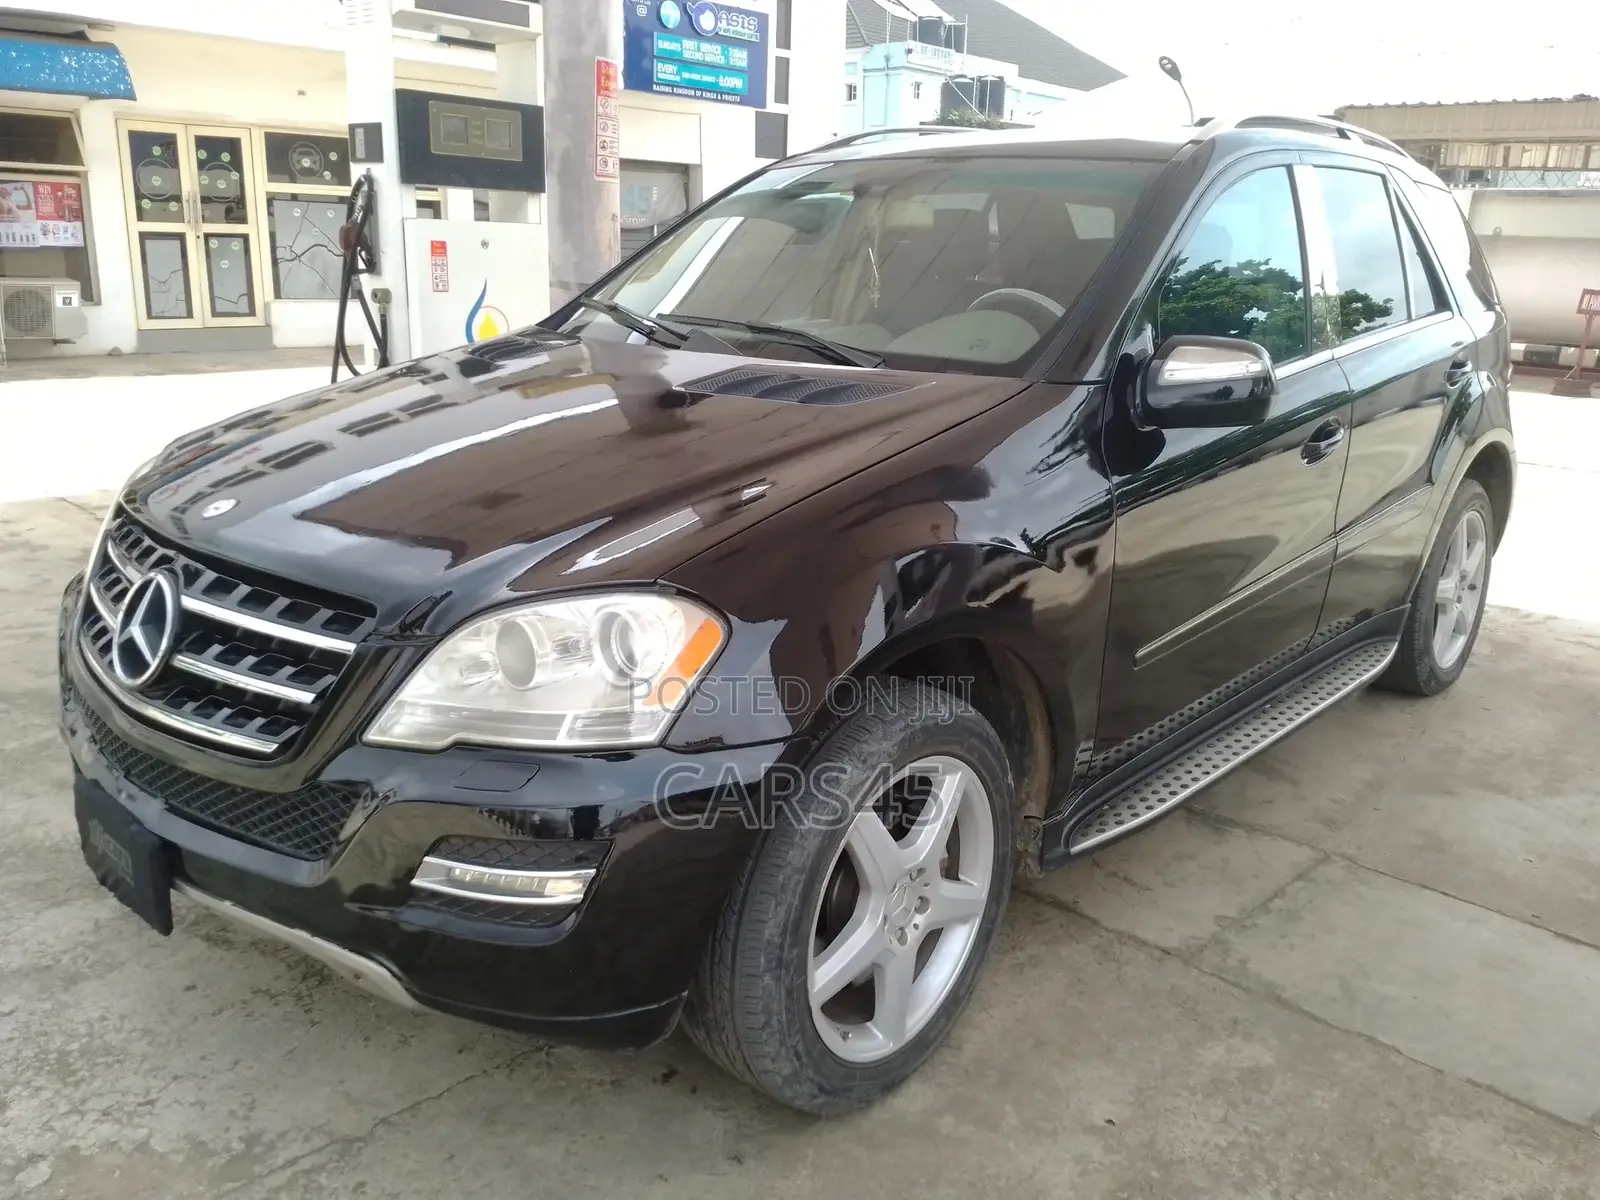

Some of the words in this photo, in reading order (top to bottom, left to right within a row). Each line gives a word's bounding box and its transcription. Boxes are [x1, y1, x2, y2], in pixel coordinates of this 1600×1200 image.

[682, 39, 698, 51] FIRST
[700, 42, 721, 54] SERVICE
[682, 50, 704, 61] SECOND
[704, 53, 725, 64] SERVICE
[657, 62, 678, 75] EVERY
[652, 84, 673, 93] RAISING
[673, 87, 695, 96] KINGDOM
[702, 91, 717, 99] KINGS
[722, 94, 740, 103] PRIESTS
